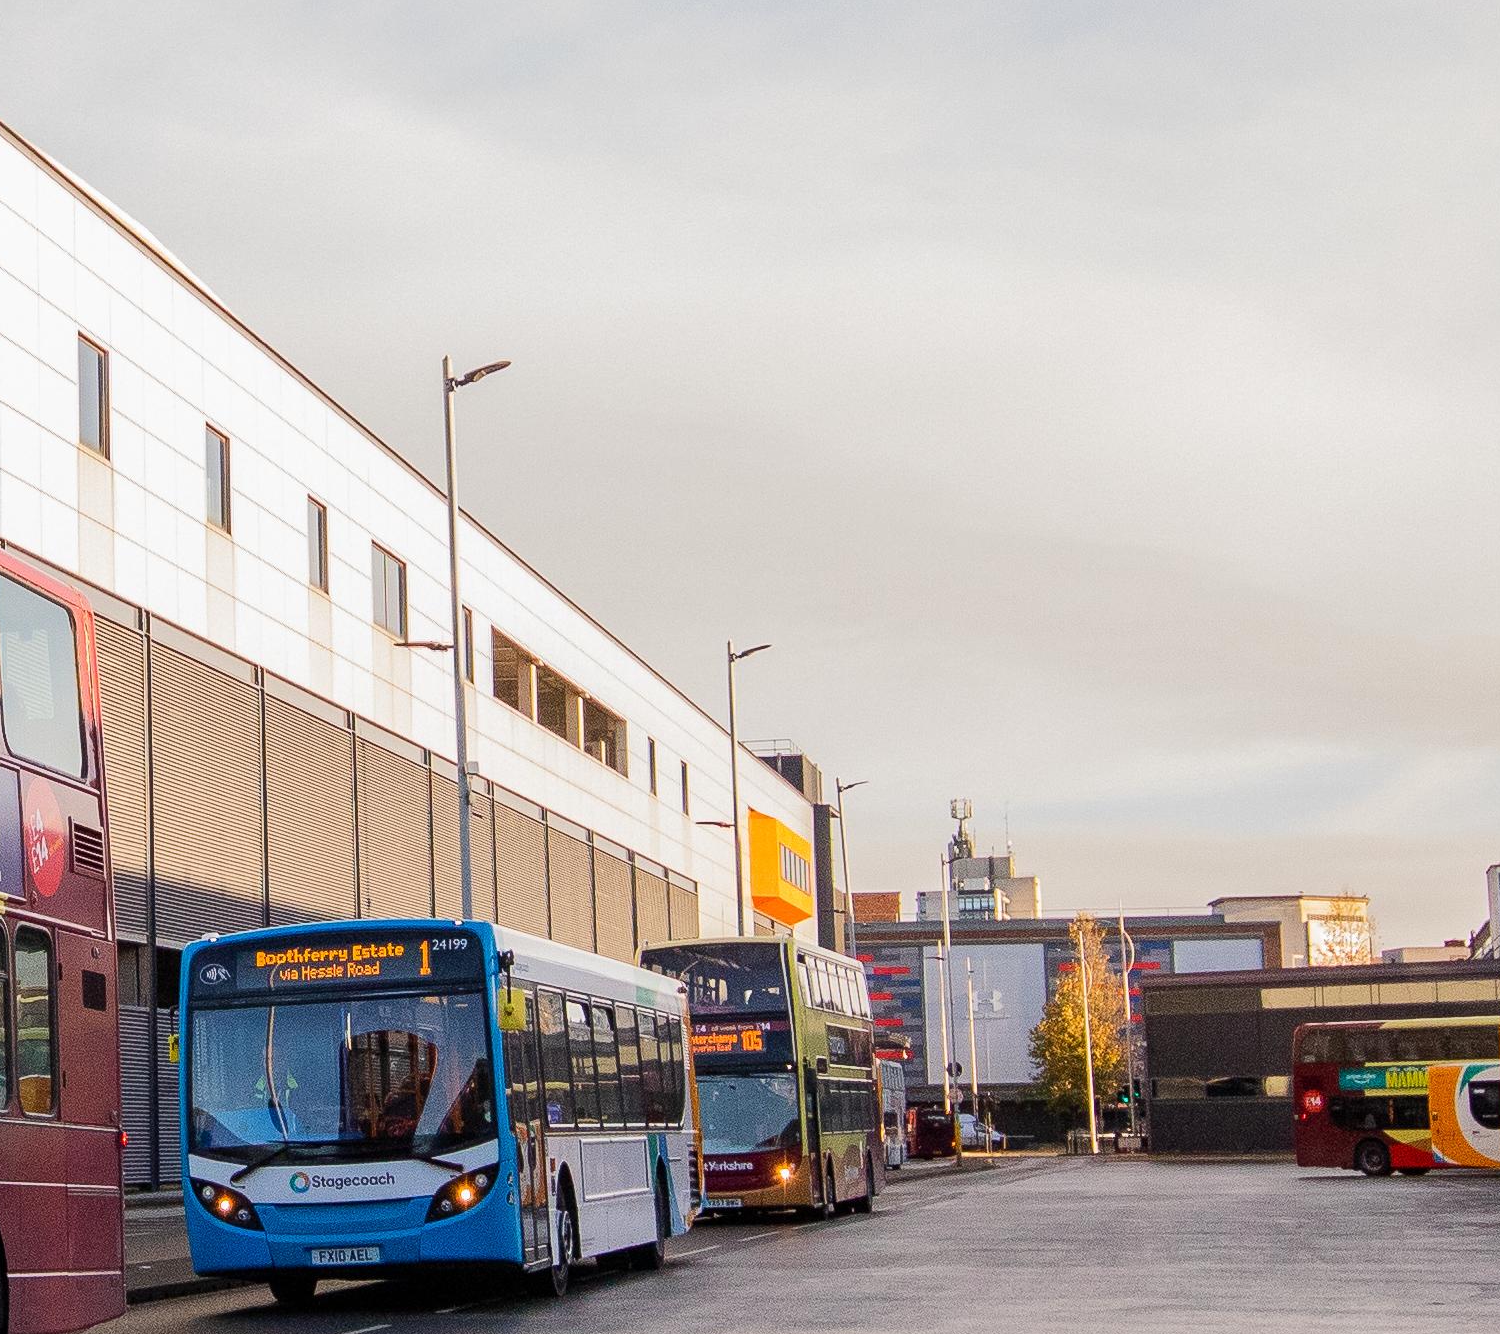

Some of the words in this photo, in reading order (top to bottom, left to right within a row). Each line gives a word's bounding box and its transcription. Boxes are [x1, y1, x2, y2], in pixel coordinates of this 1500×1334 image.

[256, 946, 348, 968] Boothferry
[352, 938, 404, 960] Estate
[432, 938, 468, 951] 24199
[419, 939, 431, 976] 1
[279, 967, 299, 980] via
[301, 964, 343, 981] Hessle
[347, 961, 380, 978] Road
[741, 1030, 763, 1051] 105
[311, 1172, 395, 1190] Stagecoach
[318, 1249, 347, 1263] FX10
[349, 1247, 373, 1262] AEL
